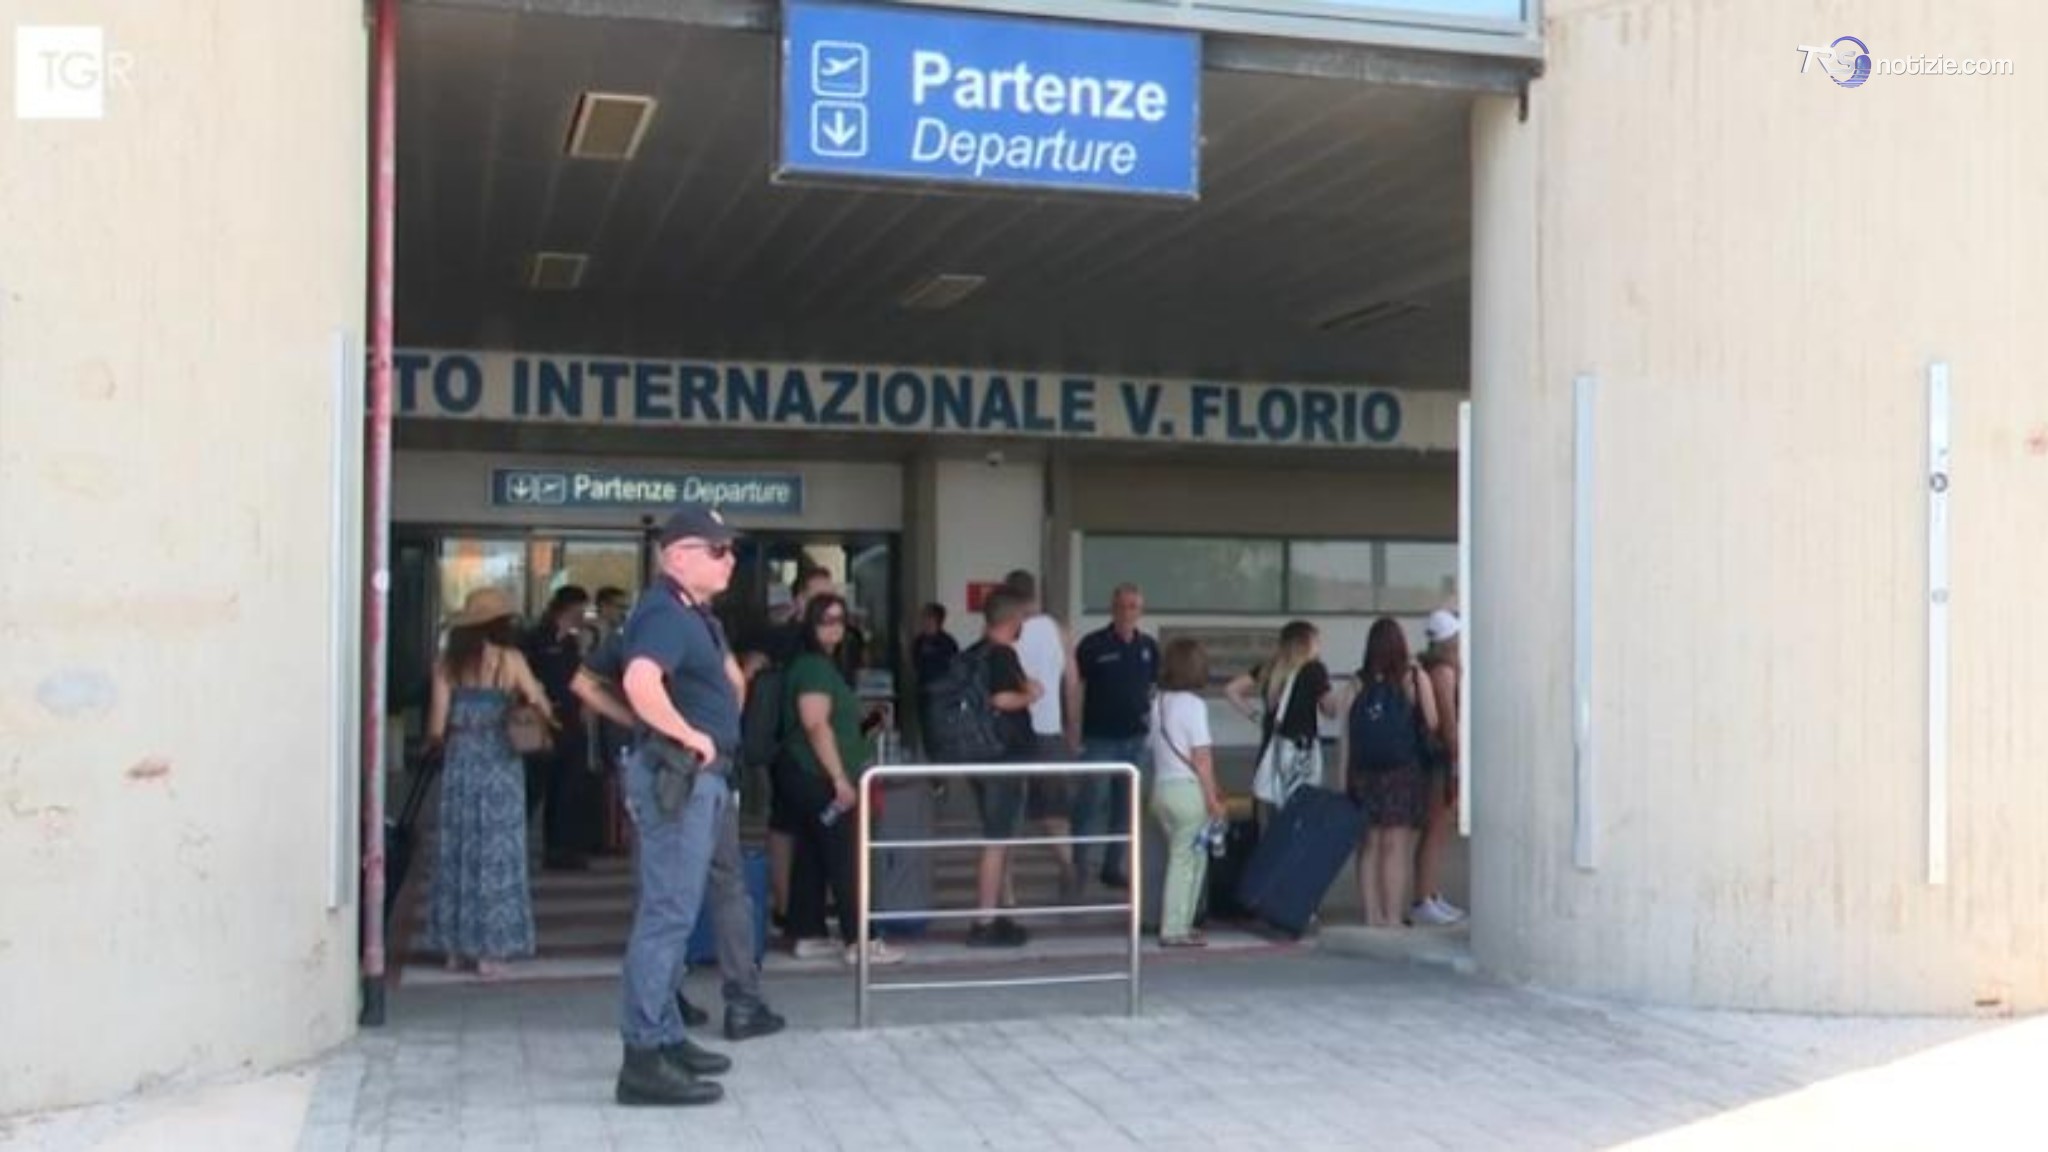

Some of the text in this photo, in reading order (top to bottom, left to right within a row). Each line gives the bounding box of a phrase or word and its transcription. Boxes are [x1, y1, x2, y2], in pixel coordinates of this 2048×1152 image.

[911, 50, 1168, 123] Partenze
[911, 117, 1137, 177] Departure
[512, 357, 1096, 434] INTERNAZIONALE
[1120, 383, 1175, 437] V.
[1191, 385, 1402, 443] FLORIO
[573, 474, 791, 509] Partenze Departure
